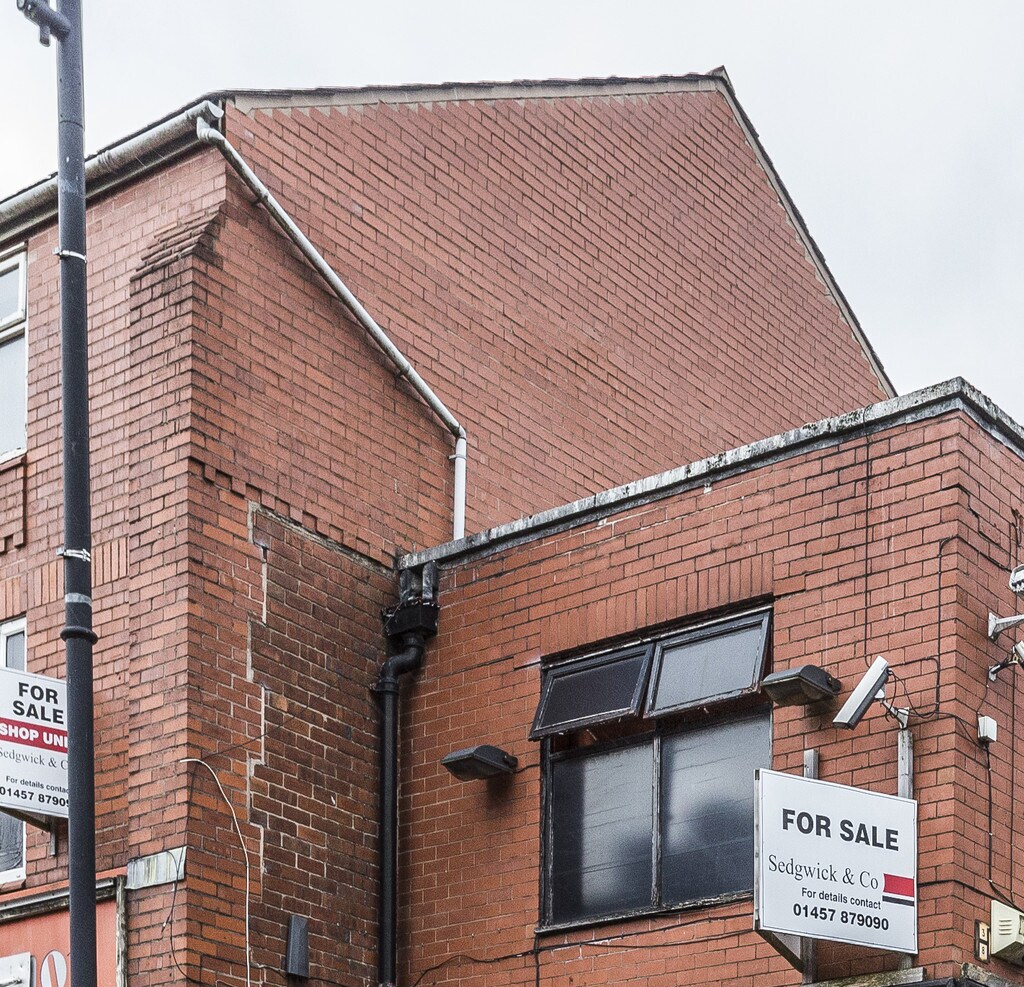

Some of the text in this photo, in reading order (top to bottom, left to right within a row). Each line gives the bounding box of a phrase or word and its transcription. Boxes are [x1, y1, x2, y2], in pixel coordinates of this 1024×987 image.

[18, 682, 58, 705] FOR
[12, 700, 64, 725] SALE
[0, 723, 68, 749] SHOP UNI
[0, 746, 68, 770] Sedgwick & C
[0, 786, 34, 801] 01457
[6, 775, 18, 784] For
[20, 778, 44, 789] details
[782, 808, 899, 851] FOR SALE
[768, 854, 879, 889] Sedgwick & Co
[801, 887, 881, 910] For details contact
[793, 903, 889, 931] 01457 879090
